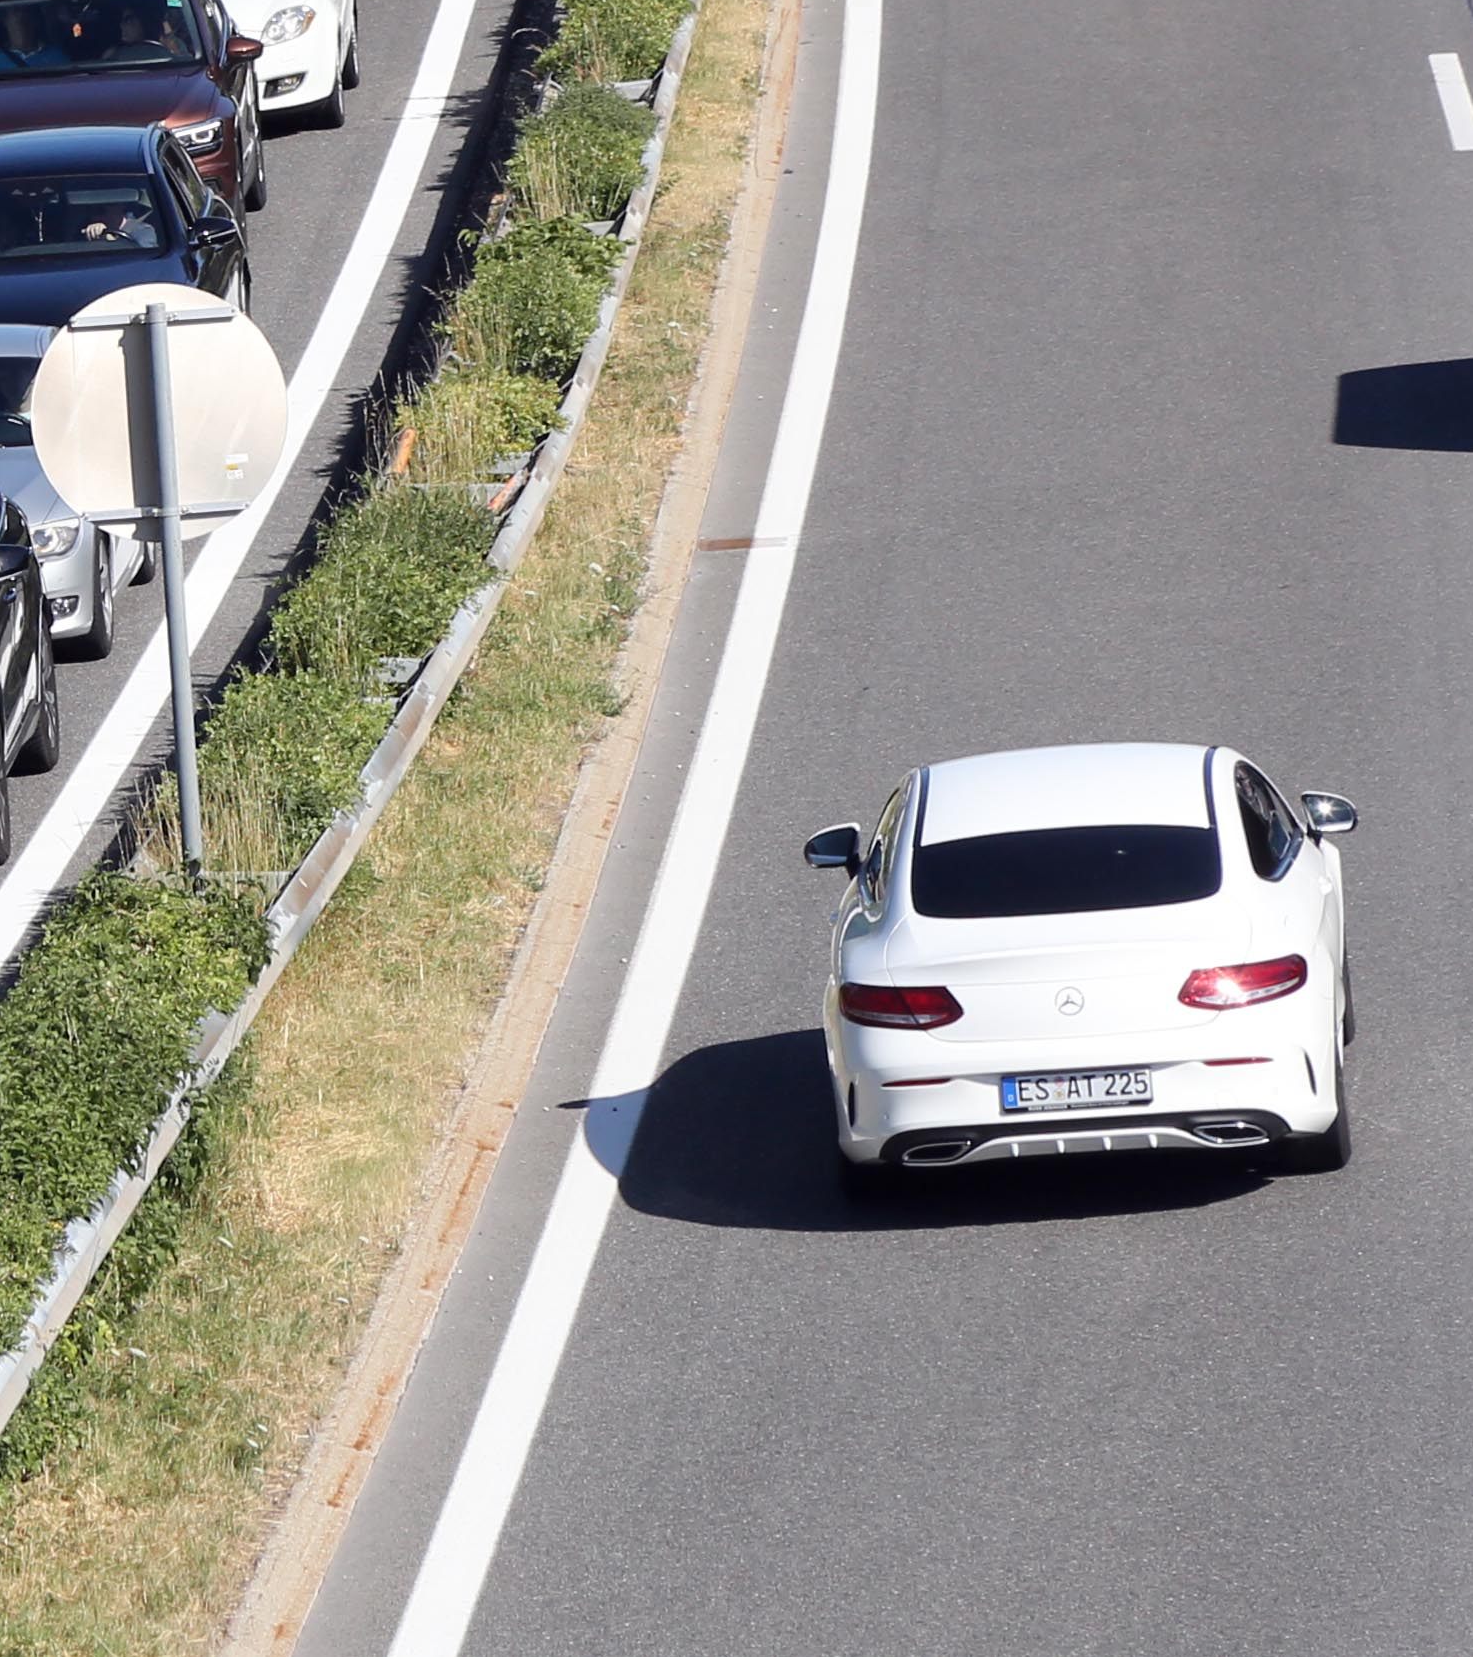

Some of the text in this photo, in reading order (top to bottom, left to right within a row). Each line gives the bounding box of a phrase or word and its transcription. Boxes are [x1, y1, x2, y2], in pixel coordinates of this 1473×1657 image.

[1018, 1077, 1050, 1102] ES
[1067, 1074, 1096, 1099] AT
[1104, 1071, 1148, 1096] 225
